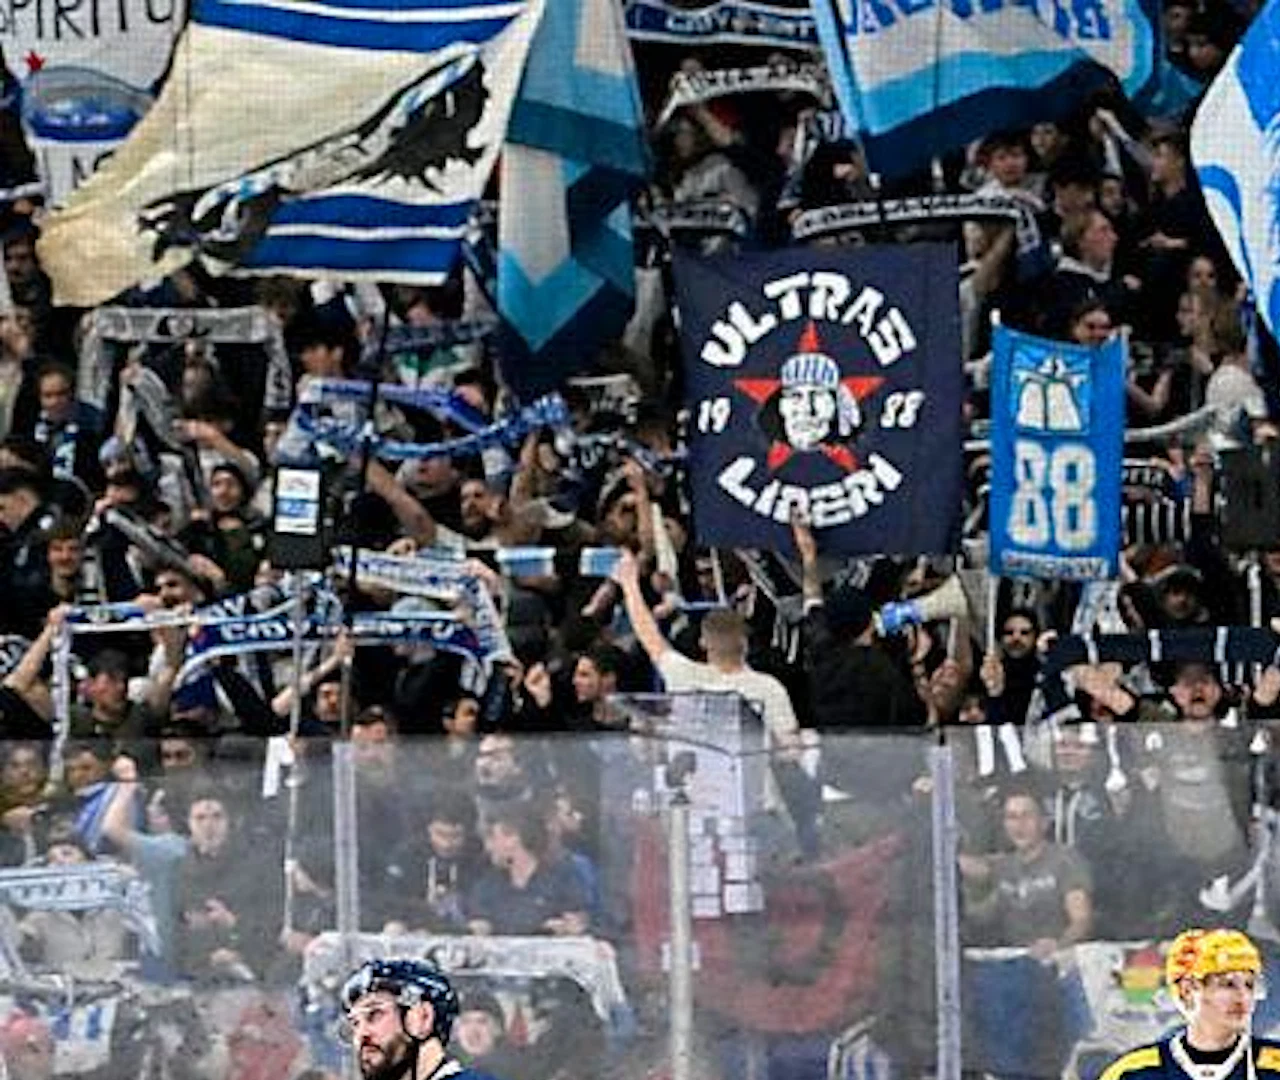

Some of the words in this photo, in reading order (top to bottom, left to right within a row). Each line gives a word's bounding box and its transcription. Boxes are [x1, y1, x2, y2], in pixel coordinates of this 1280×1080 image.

[700, 271, 917, 366] ULTRAS
[697, 397, 731, 433] 19
[880, 392, 924, 428] 88
[717, 452, 903, 528] LIBERI
[1007, 440, 1098, 551] 88
